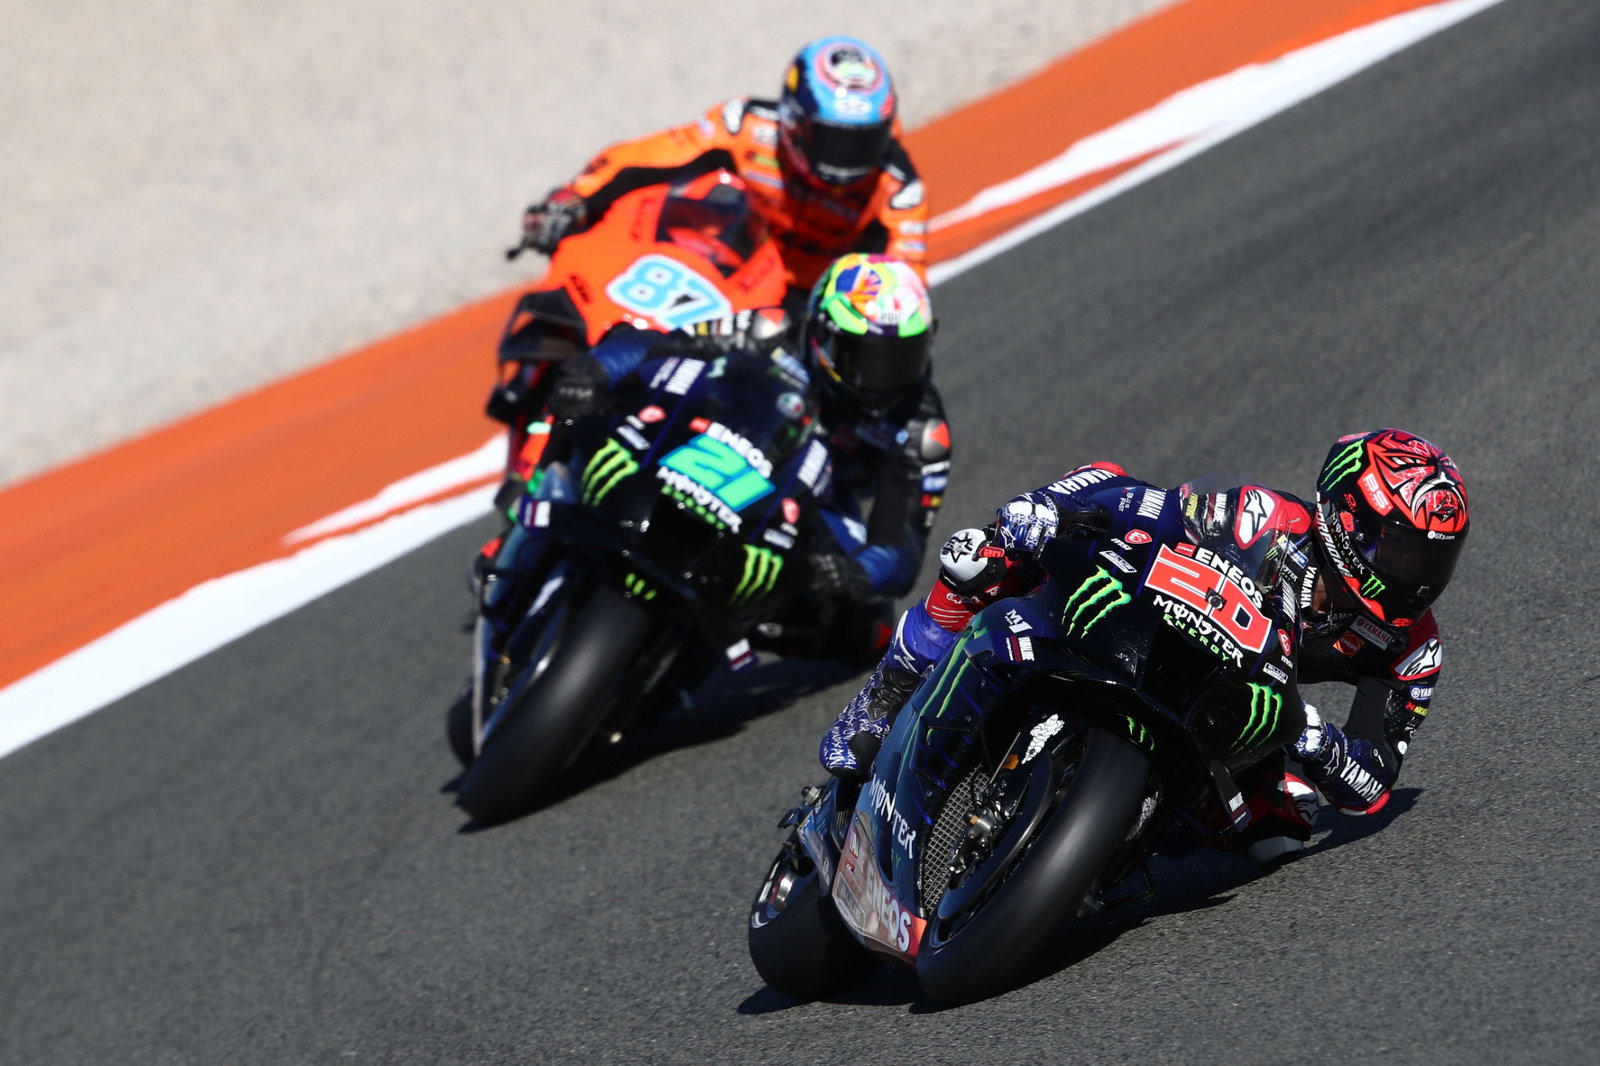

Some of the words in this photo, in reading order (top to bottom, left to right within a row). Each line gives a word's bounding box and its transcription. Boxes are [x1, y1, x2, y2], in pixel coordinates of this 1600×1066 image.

[605, 254, 733, 331] 87
[657, 434, 776, 513] 21
[1047, 468, 1117, 495] YAMAHA
[1364, 473, 1390, 510] BS
[1330, 512, 1365, 575] MONSTER
[1144, 543, 1272, 653] 20
[1195, 547, 1263, 609] ENEOS
[1301, 566, 1318, 609] YAMAHA
[1153, 595, 1244, 668] MONSTER
[1163, 613, 1230, 661] ENERGY
[1363, 620, 1392, 644] YAMAHA
[1340, 756, 1387, 803] YAMAH
[868, 774, 917, 860] MONTER
